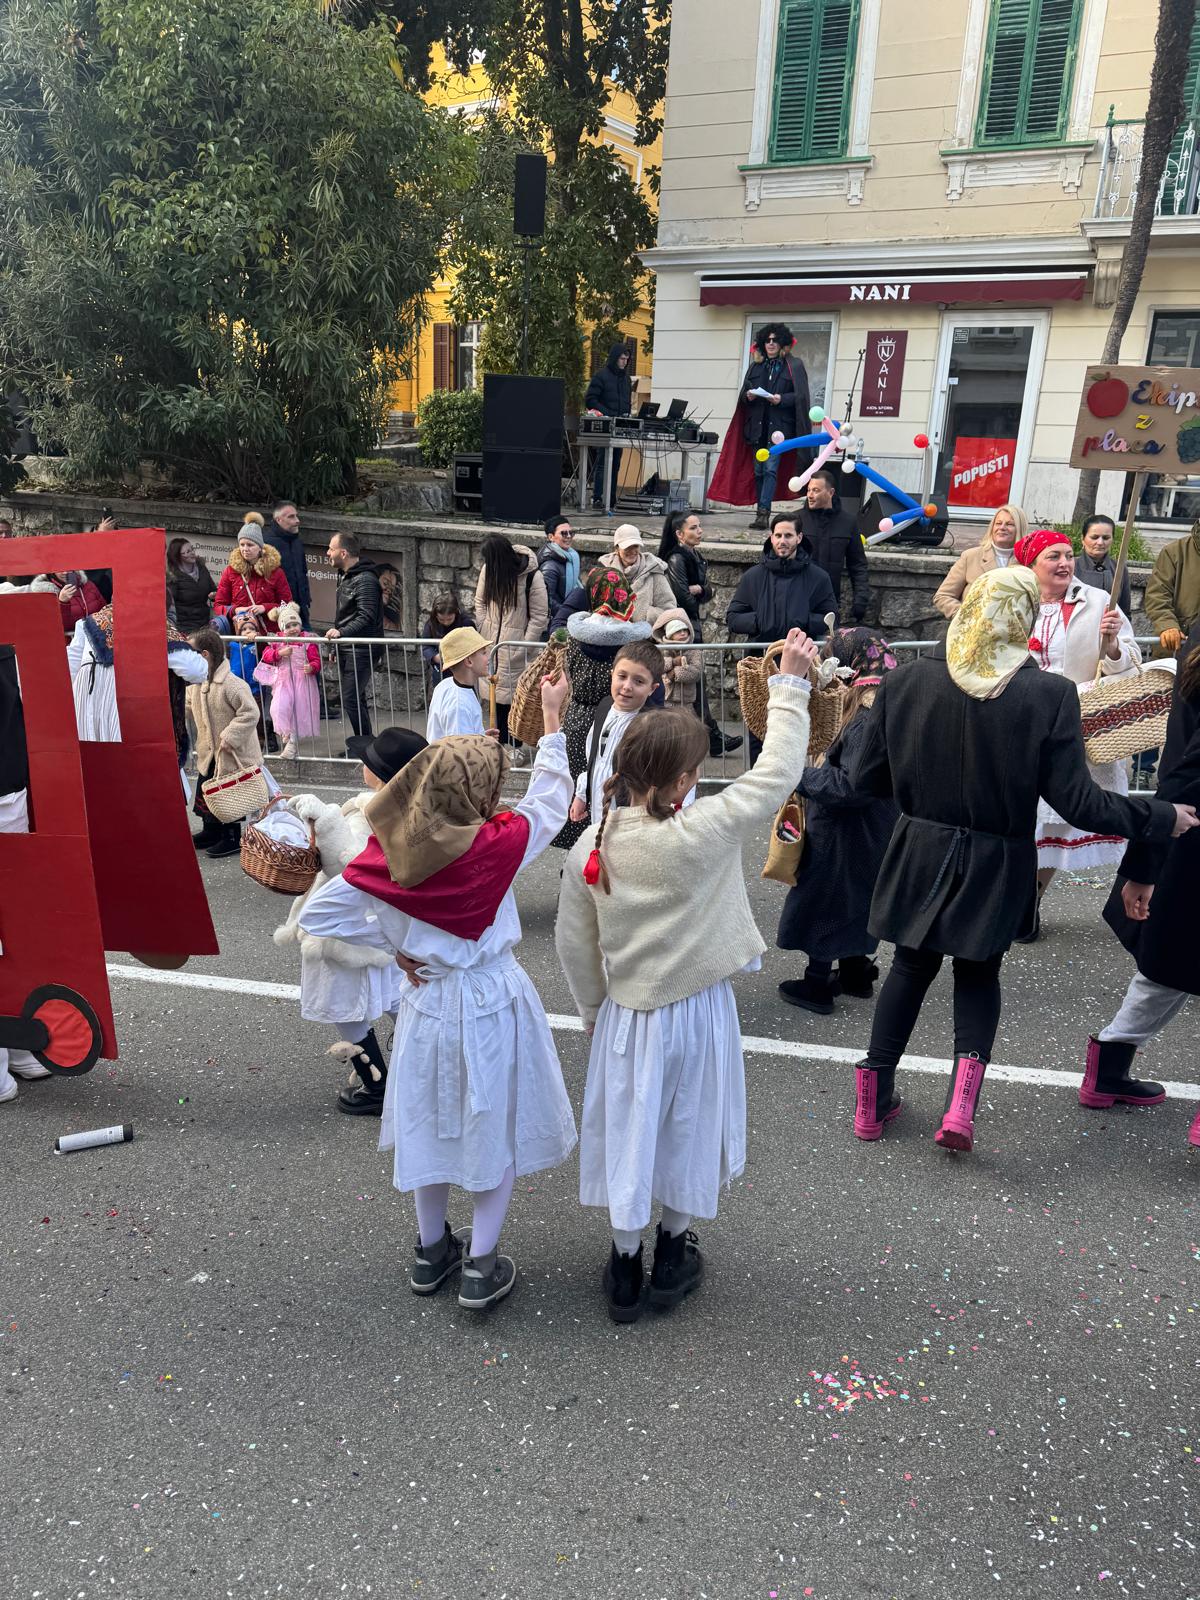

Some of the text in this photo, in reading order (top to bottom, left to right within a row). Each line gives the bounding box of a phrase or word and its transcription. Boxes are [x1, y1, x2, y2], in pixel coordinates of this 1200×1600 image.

[850, 285, 911, 300] NANI
[1081, 428, 1166, 457] placa
[954, 454, 1008, 488] POPUSTI
[860, 1074, 870, 1118] RUBBER
[959, 1064, 976, 1111] RUBBER
